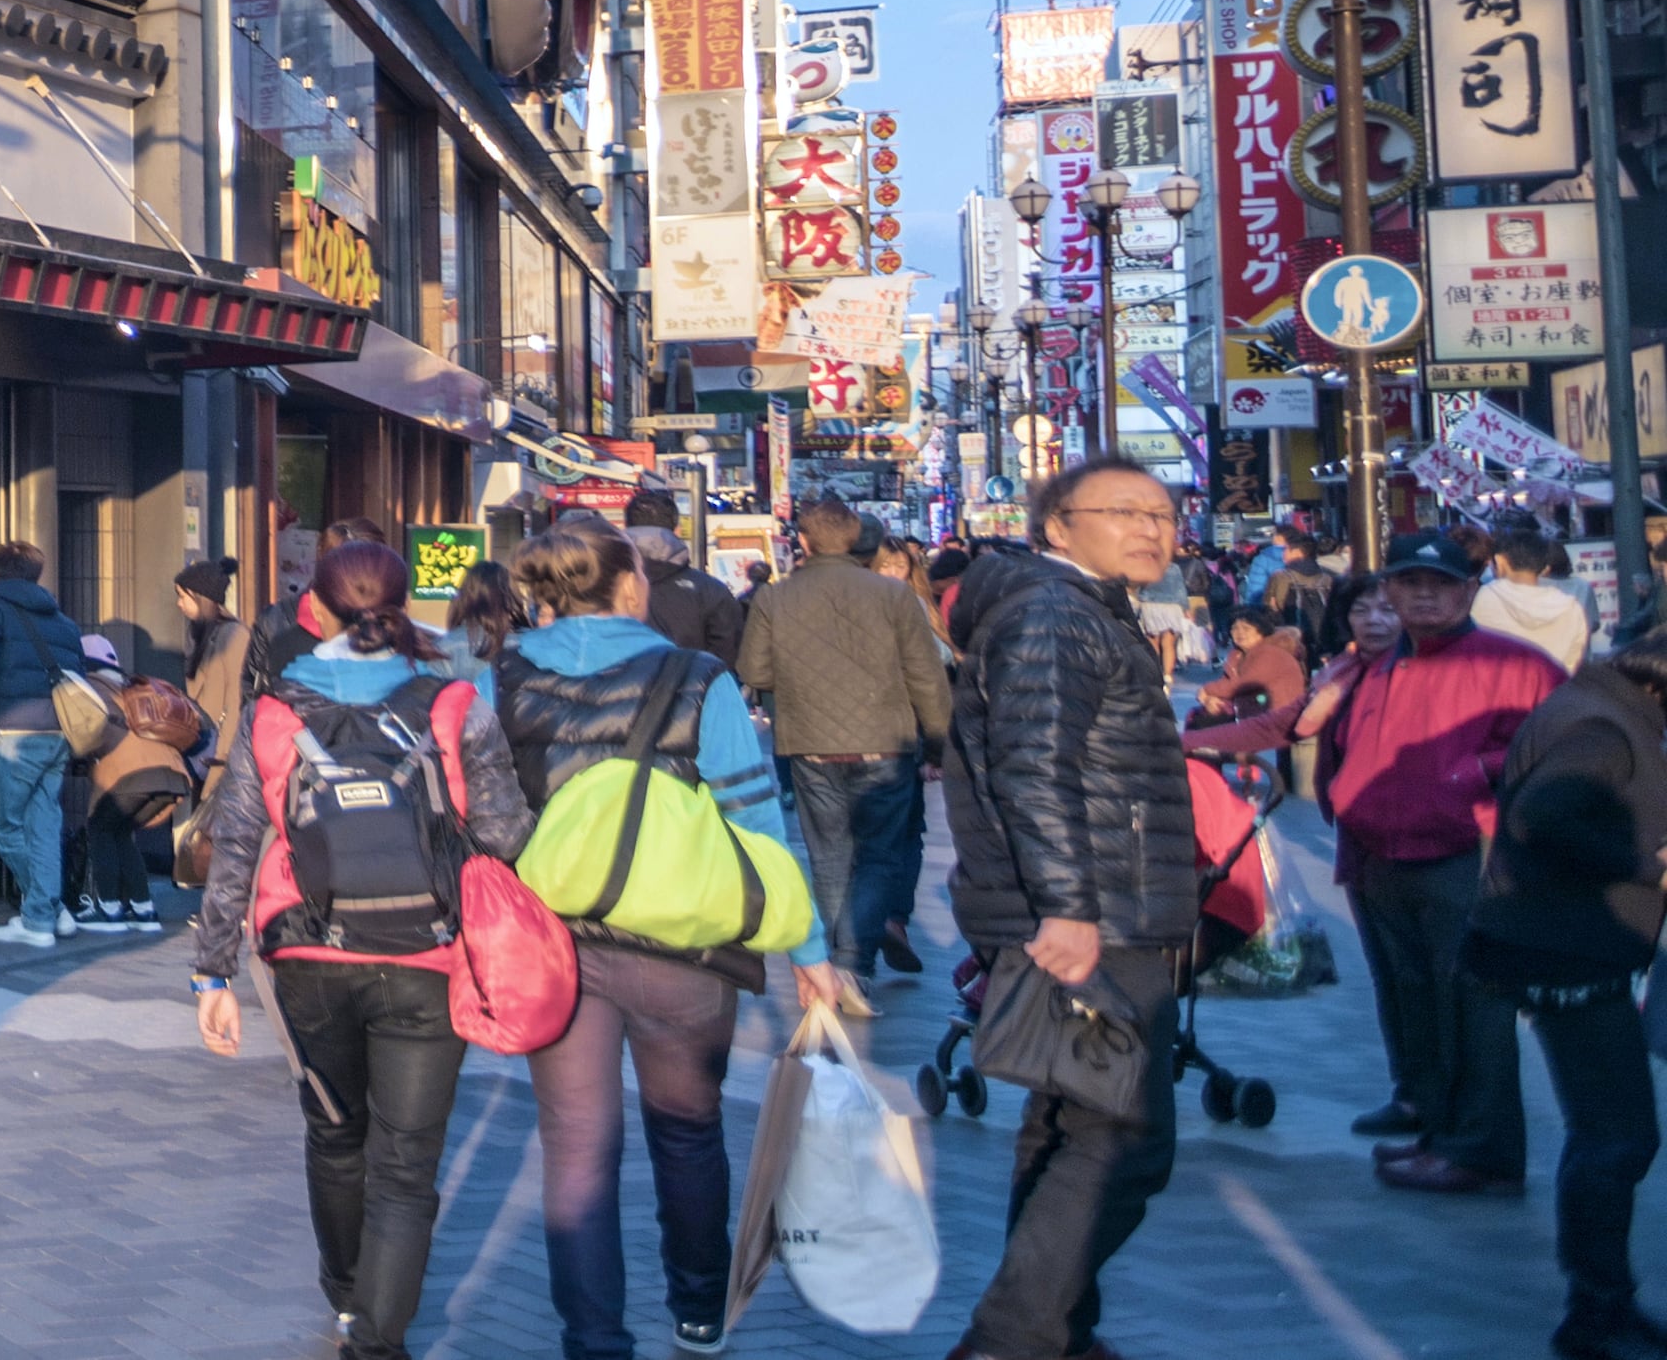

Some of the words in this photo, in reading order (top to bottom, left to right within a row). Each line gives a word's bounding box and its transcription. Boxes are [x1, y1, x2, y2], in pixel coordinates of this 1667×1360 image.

[1221, 8, 1238, 50] SHOP
[1131, 96, 1152, 165] インターネット
[1230, 58, 1289, 297] ツルハドラッグ
[767, 136, 861, 271] 大阪
[660, 225, 689, 246] 6F
[1443, 280, 1603, 306] 個室・お座敷
[1462, 322, 1592, 348] 寿司・和食
[1429, 364, 1524, 381] 個室・和食
[417, 542, 478, 569] びっくり
[415, 564, 467, 589] ドンキ
[778, 1229, 820, 1244] ART
